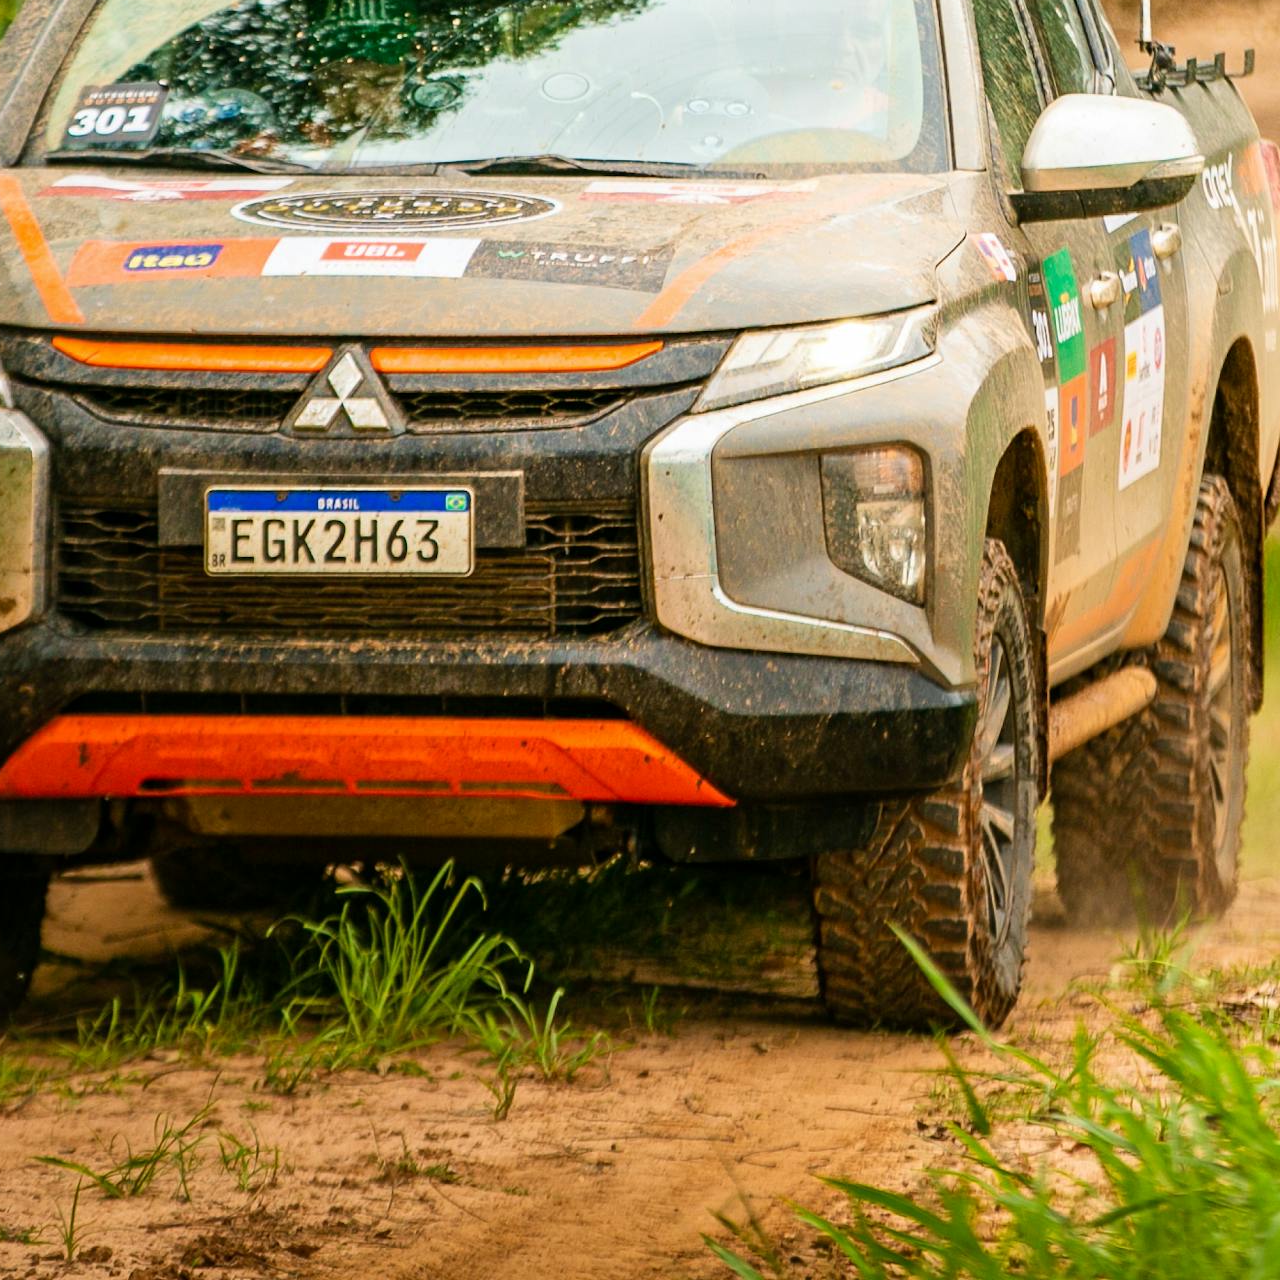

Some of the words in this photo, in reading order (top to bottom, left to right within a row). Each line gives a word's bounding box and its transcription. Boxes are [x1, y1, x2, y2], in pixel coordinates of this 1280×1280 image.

[67, 106, 151, 136] 301
[318, 498, 360, 510] BRASIL
[230, 519, 439, 563] EGK2H63
